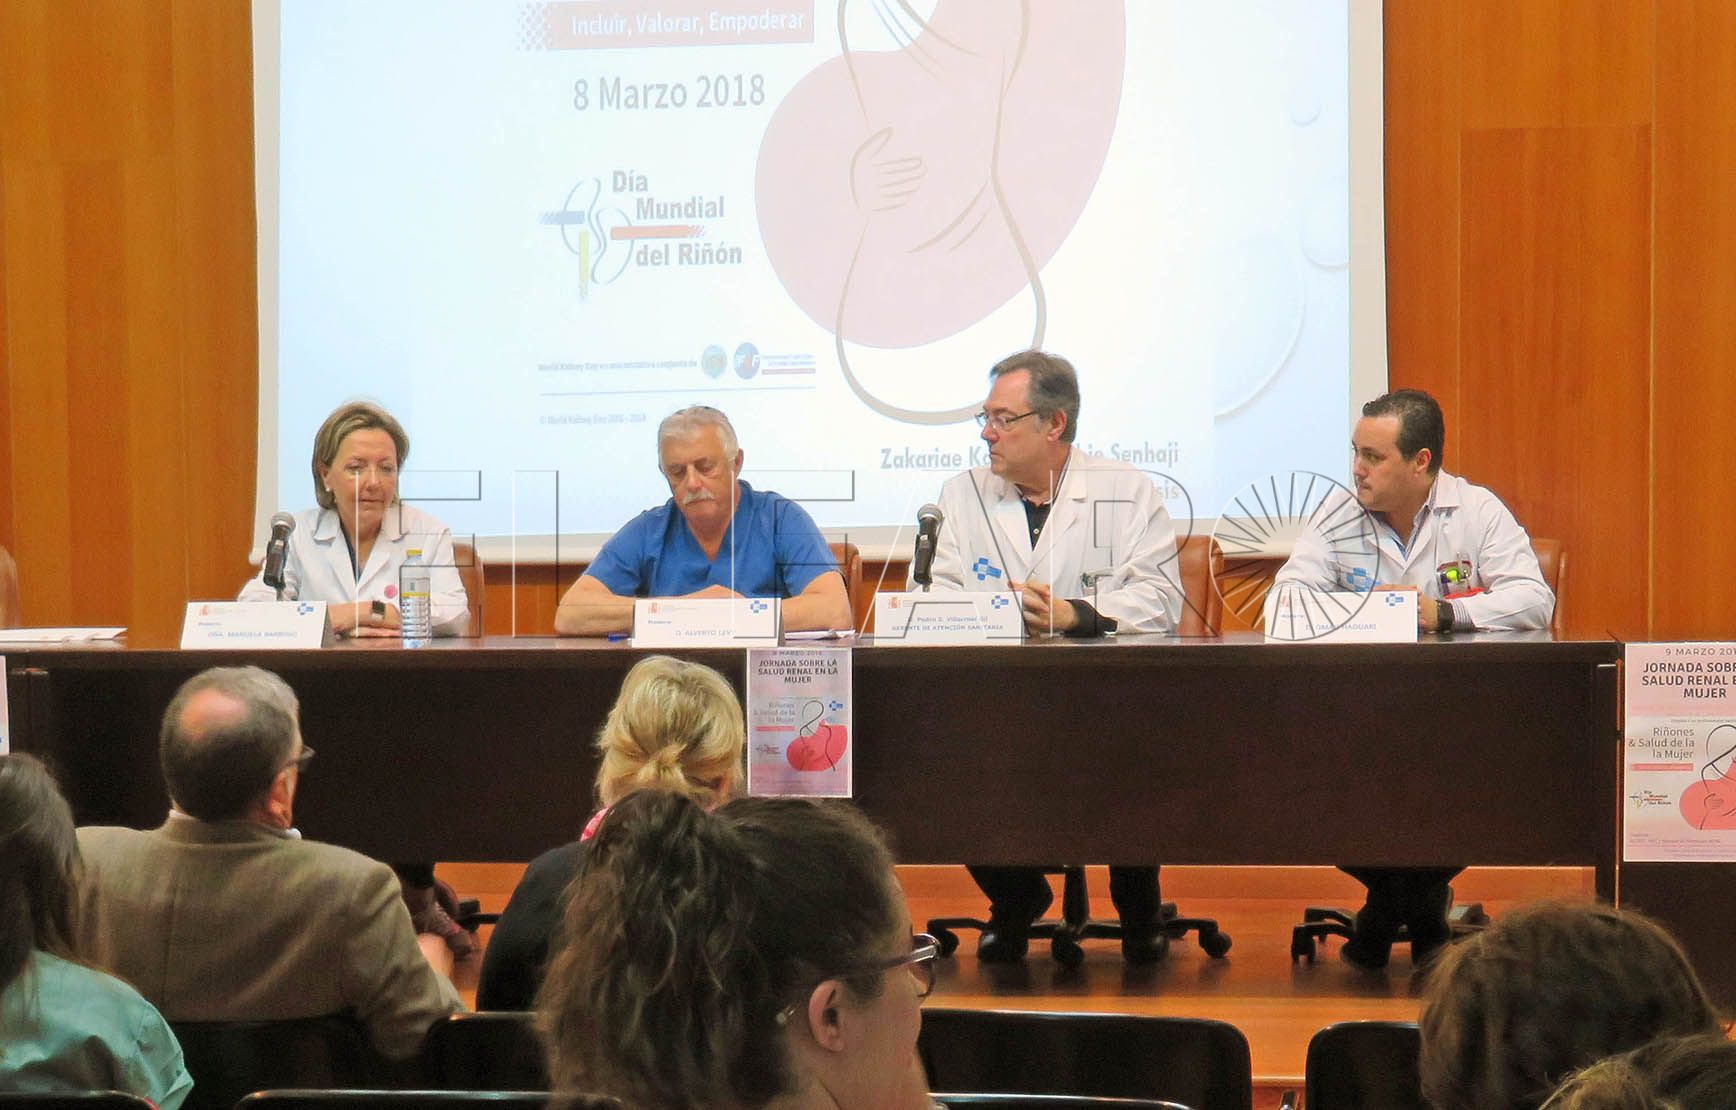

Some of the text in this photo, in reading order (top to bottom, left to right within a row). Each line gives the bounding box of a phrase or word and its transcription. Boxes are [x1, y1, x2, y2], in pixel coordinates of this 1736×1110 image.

[572, 8, 804, 39] Incluir, Valorar, Empoderar
[573, 74, 766, 111] 8 Marzo 2018
[612, 170, 648, 193] Día
[636, 196, 725, 220] Mundial
[636, 241, 742, 267] del Riñón
[880, 446, 962, 469] Zakariae
[1111, 441, 1178, 468] Senhaji
[1665, 648, 1736, 656] 9 MARZO 201
[759, 659, 839, 668] JORNADA SOBRE LA
[1643, 662, 1736, 673] JORNADA SOBR
[758, 667, 839, 675] SALUD RENAL EN LA
[784, 676, 812, 684] MUJER
[1641, 675, 1684, 686] SALUD
[1687, 675, 1729, 686] RENAL
[1683, 688, 1727, 698] MUJER
[1653, 726, 1695, 737] Riñones
[1628, 738, 1695, 748] & Salud de la
[1652, 750, 1694, 761] la Mujer
